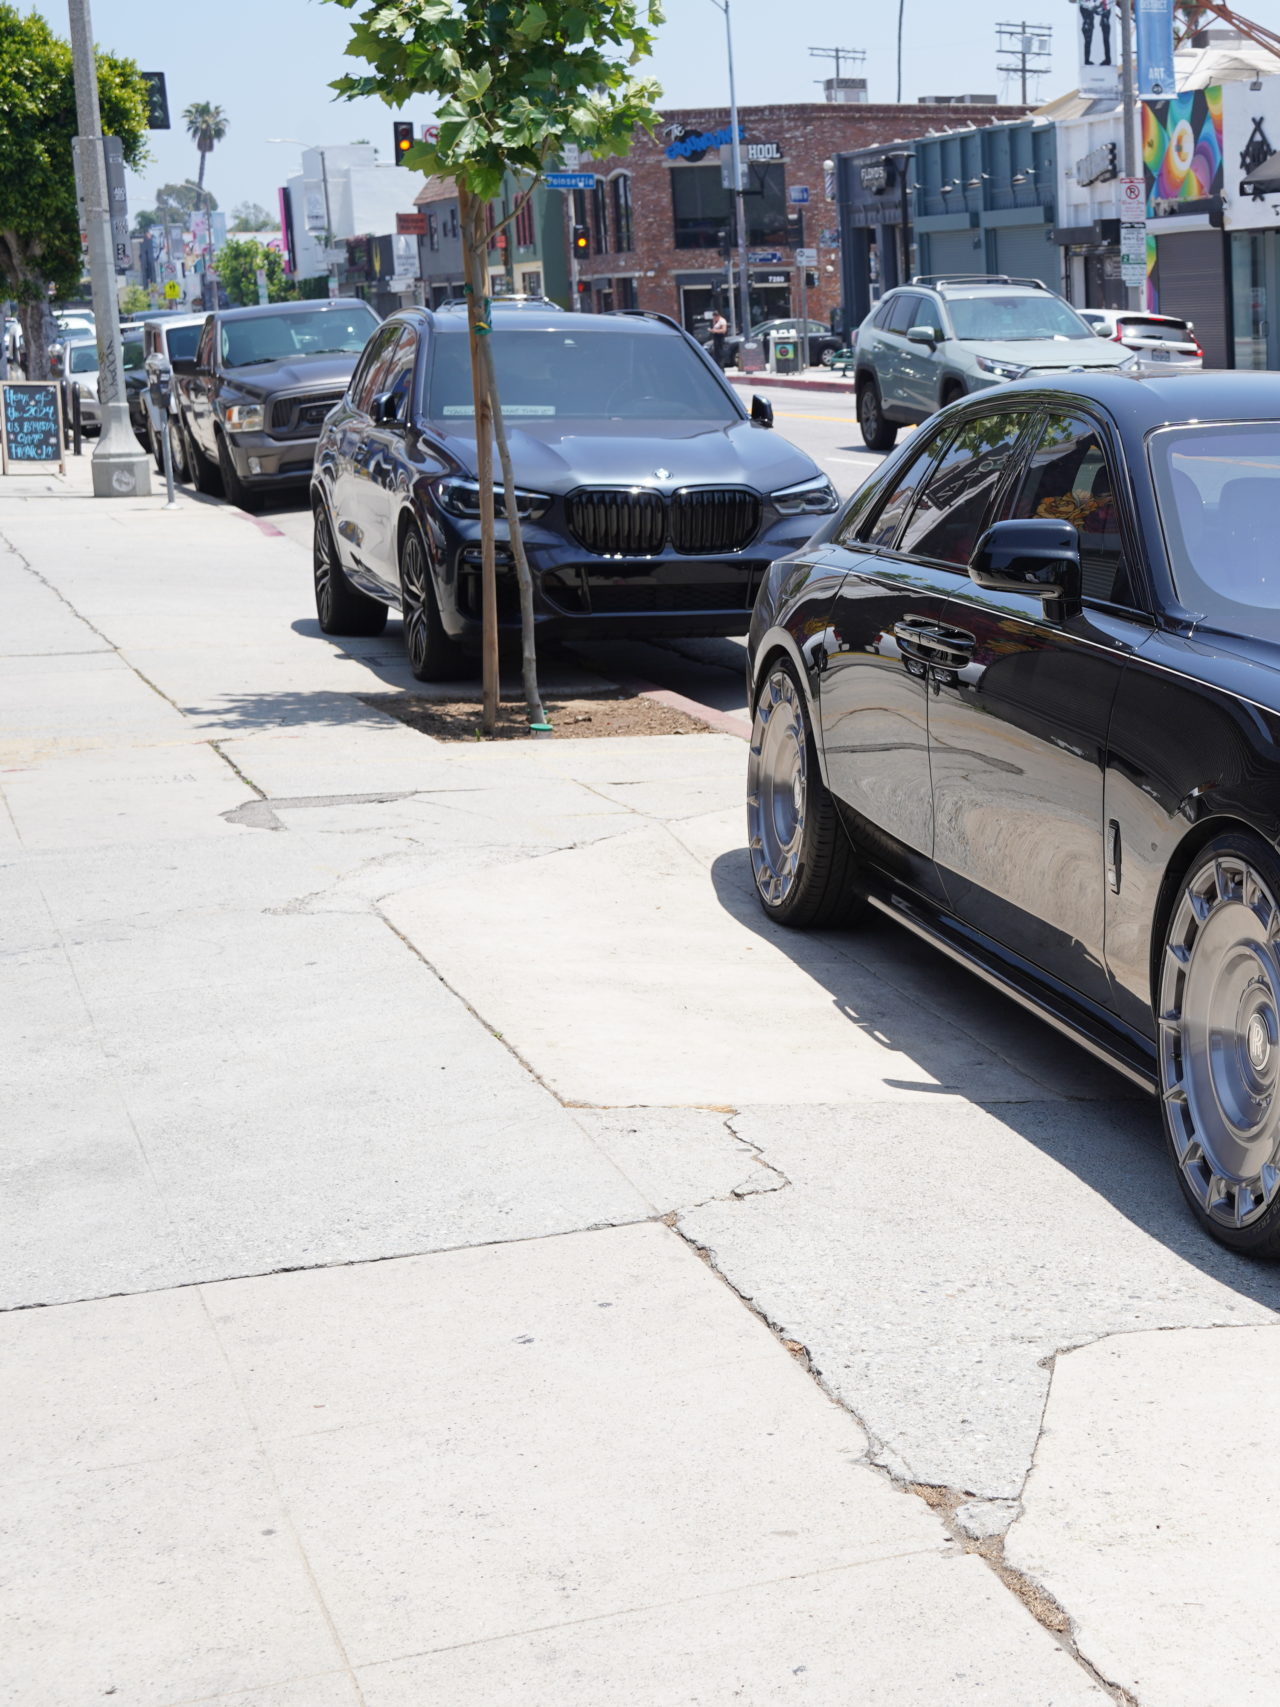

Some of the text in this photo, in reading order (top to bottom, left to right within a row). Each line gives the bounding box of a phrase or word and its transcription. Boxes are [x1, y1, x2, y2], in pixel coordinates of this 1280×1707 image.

[1148, 67, 1165, 80] ART
[749, 143, 781, 159] HOOL
[546, 176, 595, 185] Poinsettia
[23, 406, 57, 420] 2024
